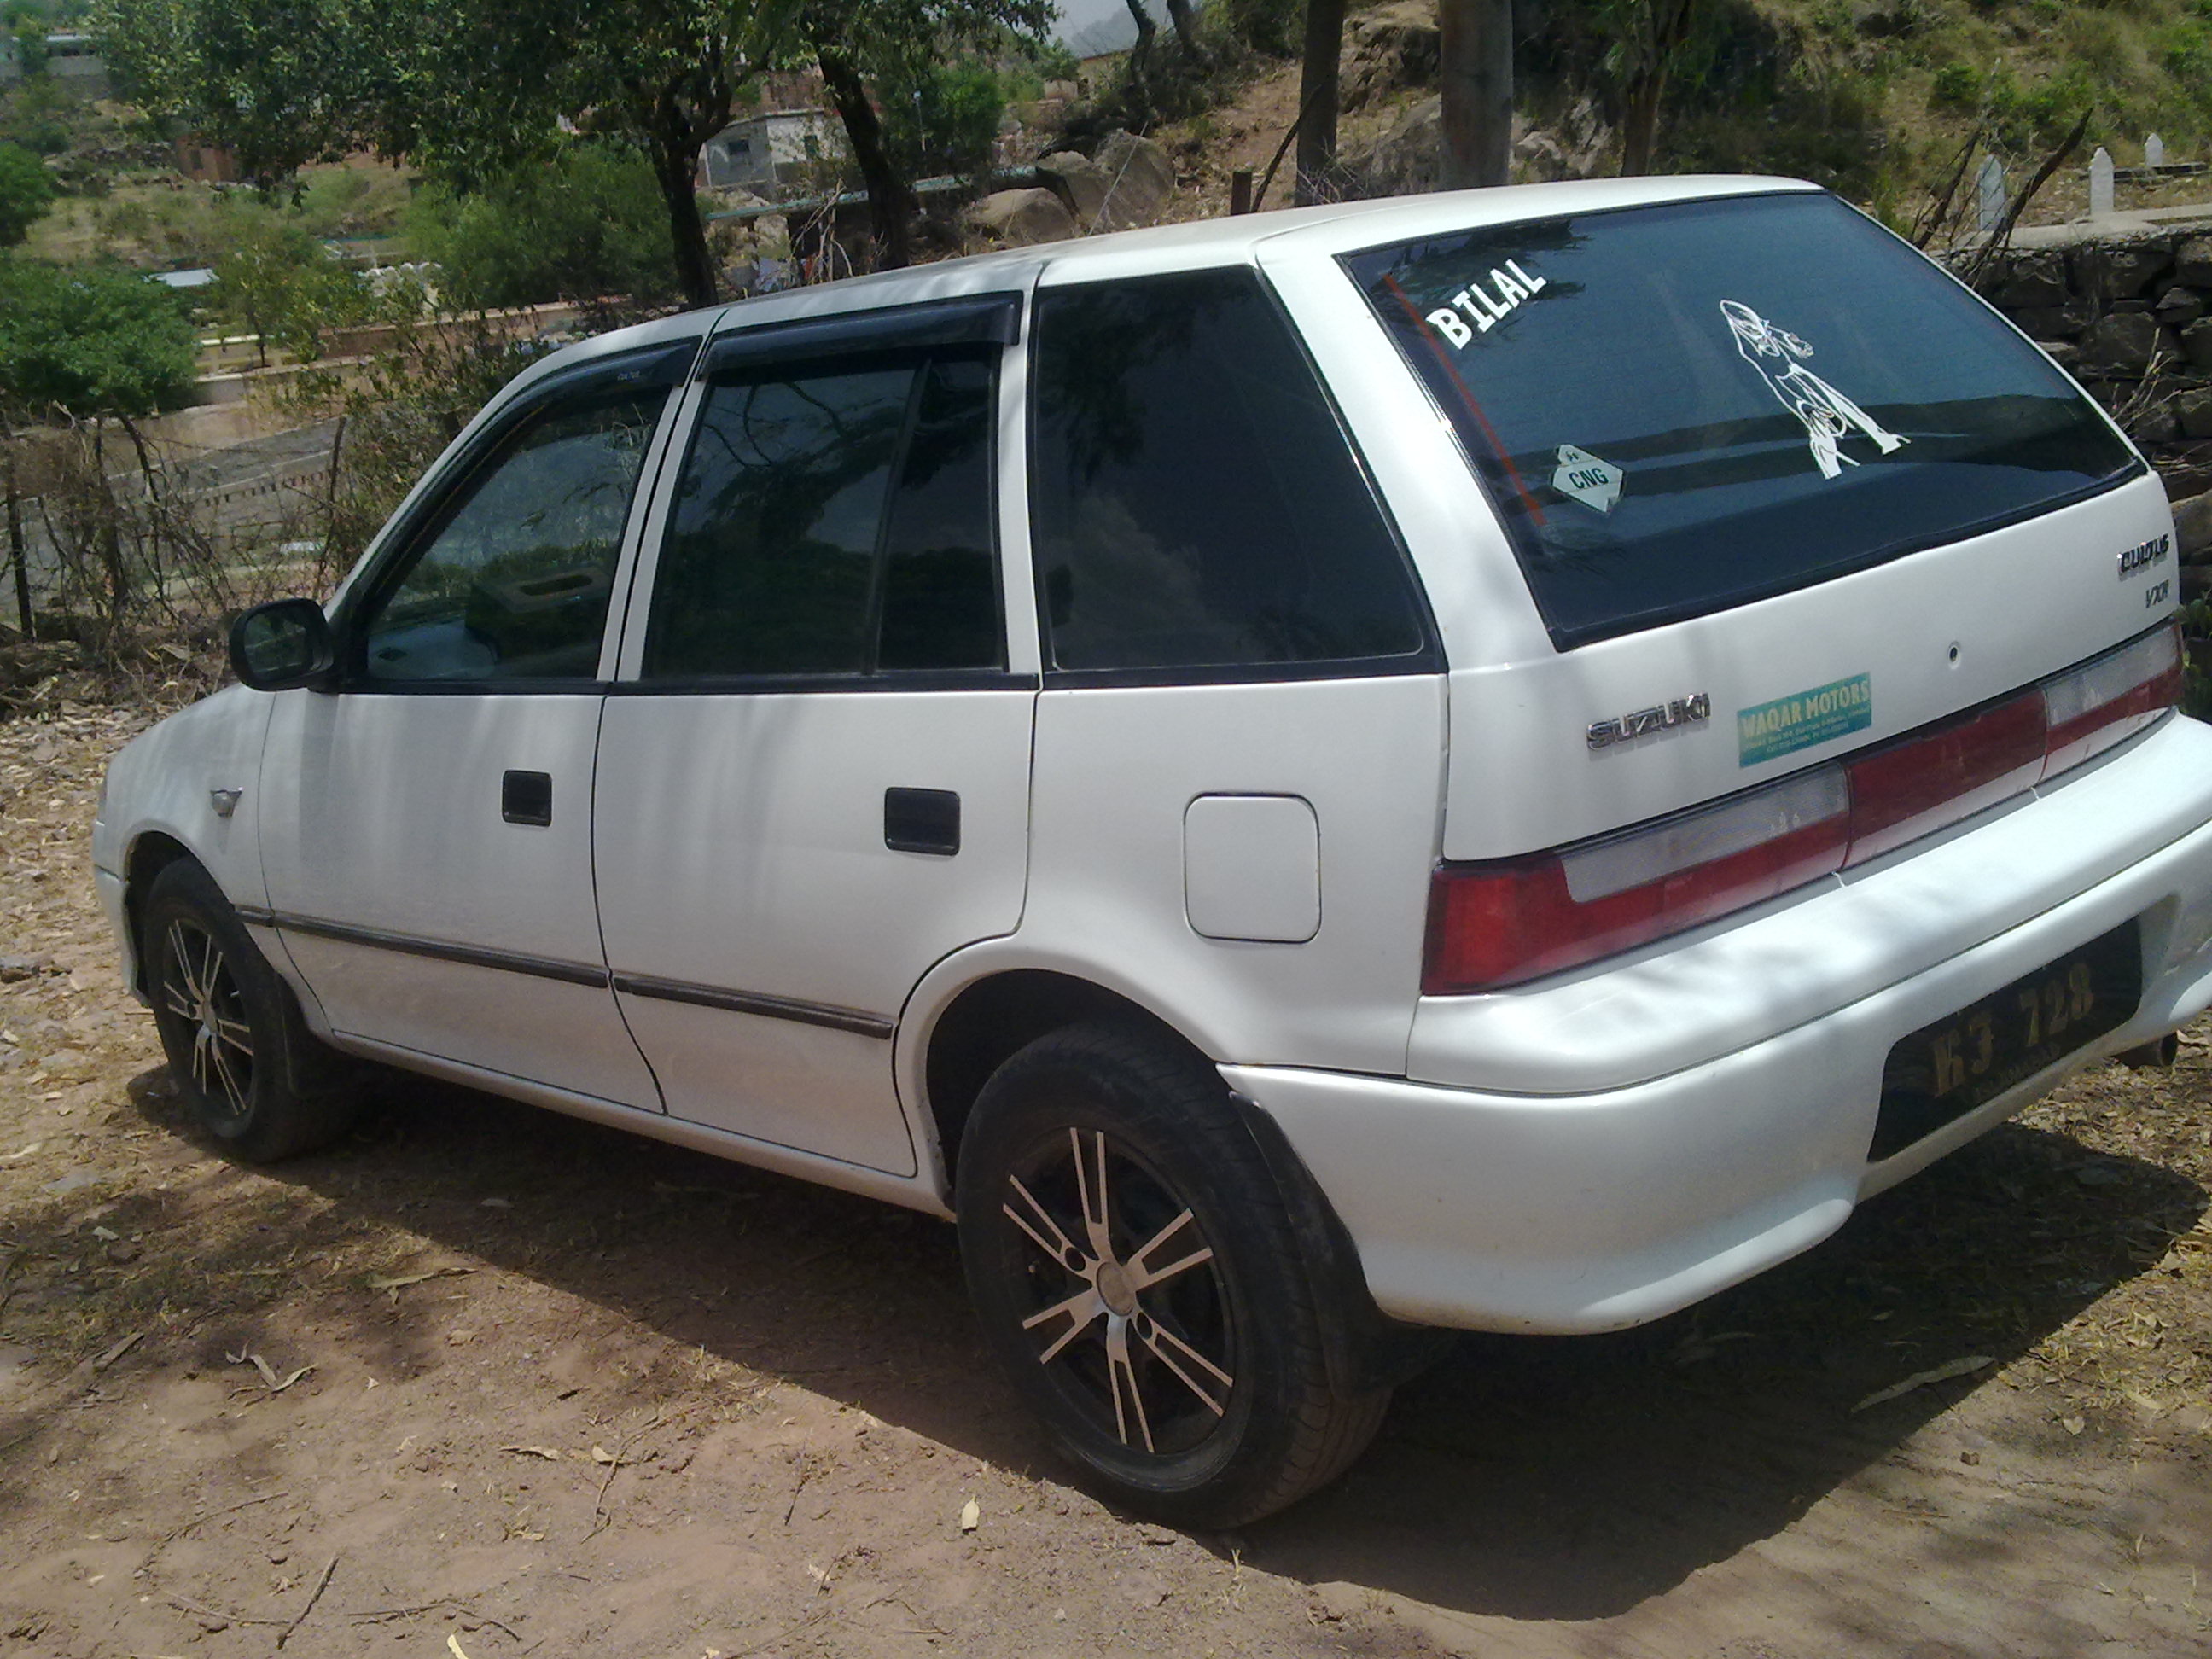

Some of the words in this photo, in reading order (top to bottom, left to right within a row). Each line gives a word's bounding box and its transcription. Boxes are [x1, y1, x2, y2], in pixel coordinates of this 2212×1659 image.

[1425, 259, 1546, 350] BILAL
[1569, 468, 1609, 489] CNG
[1586, 692, 1711, 750] SUZUKI
[1742, 701, 1802, 739] WAQAR
[1805, 680, 1870, 719] MOTORS
